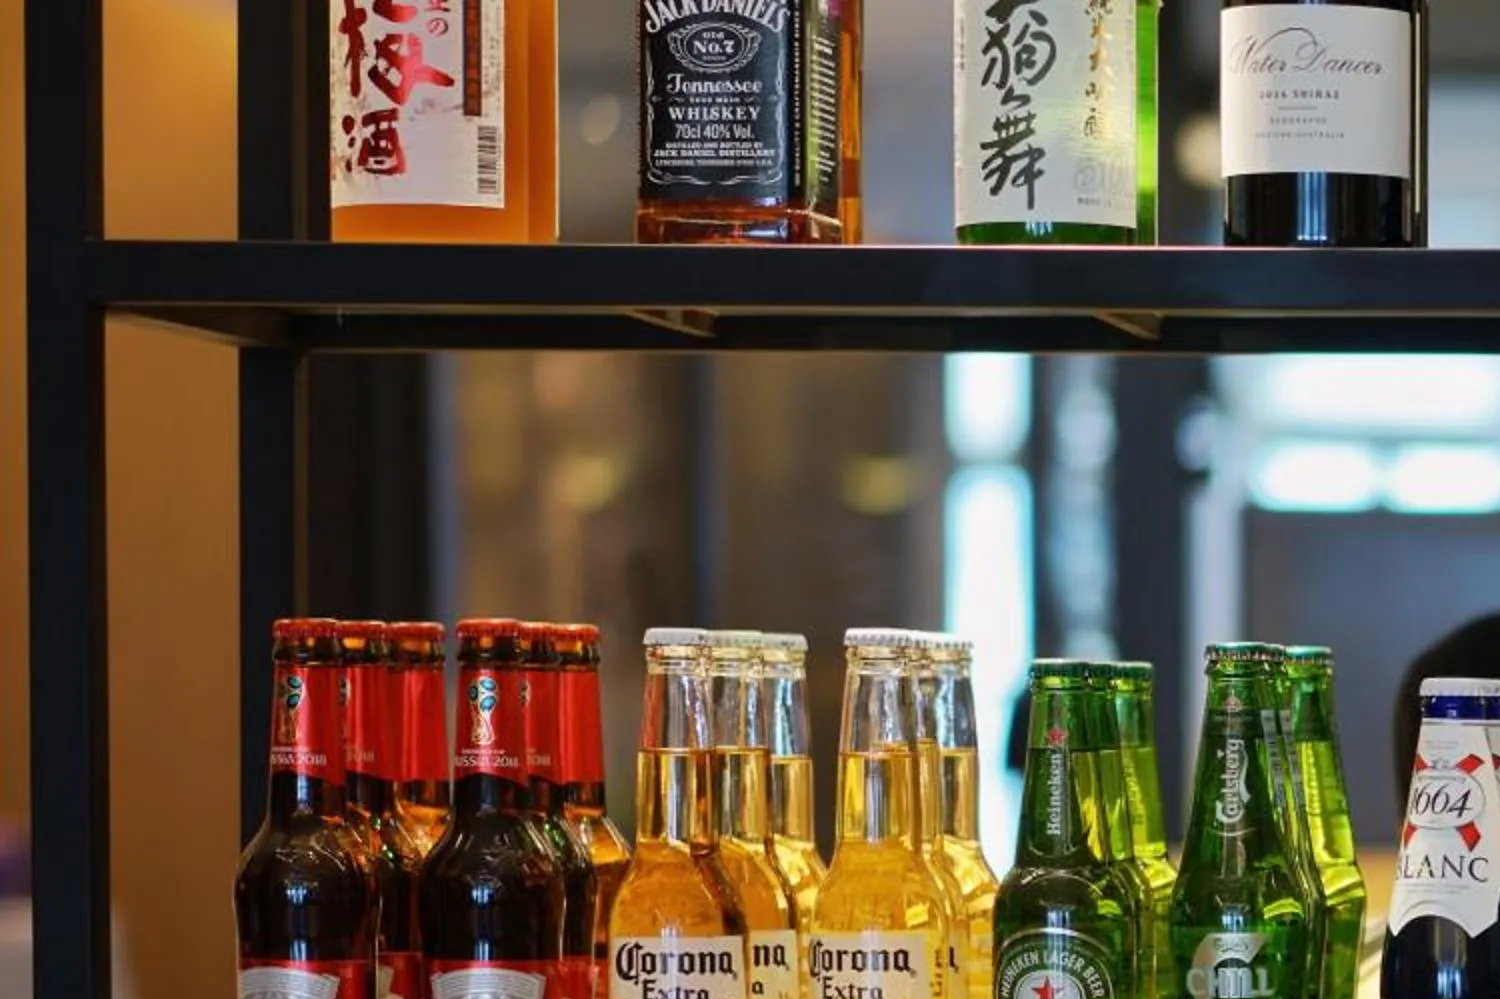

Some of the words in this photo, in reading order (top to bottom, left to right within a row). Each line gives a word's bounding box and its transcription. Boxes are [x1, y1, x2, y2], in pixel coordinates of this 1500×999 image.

[667, 73, 763, 93] Tennessee
[668, 106, 762, 121] WHISKEY
[675, 123, 701, 139] 70cl
[703, 123, 731, 139] 40%
[1047, 753, 1062, 835] Heineken
[1215, 738, 1250, 823] Carlsberg
[1410, 782, 1474, 818] 1664
[615, 941, 738, 985] Corona
[809, 937, 917, 983] Corona
[1043, 950, 1085, 973] LAGER
[1081, 964, 1105, 999] BEER
